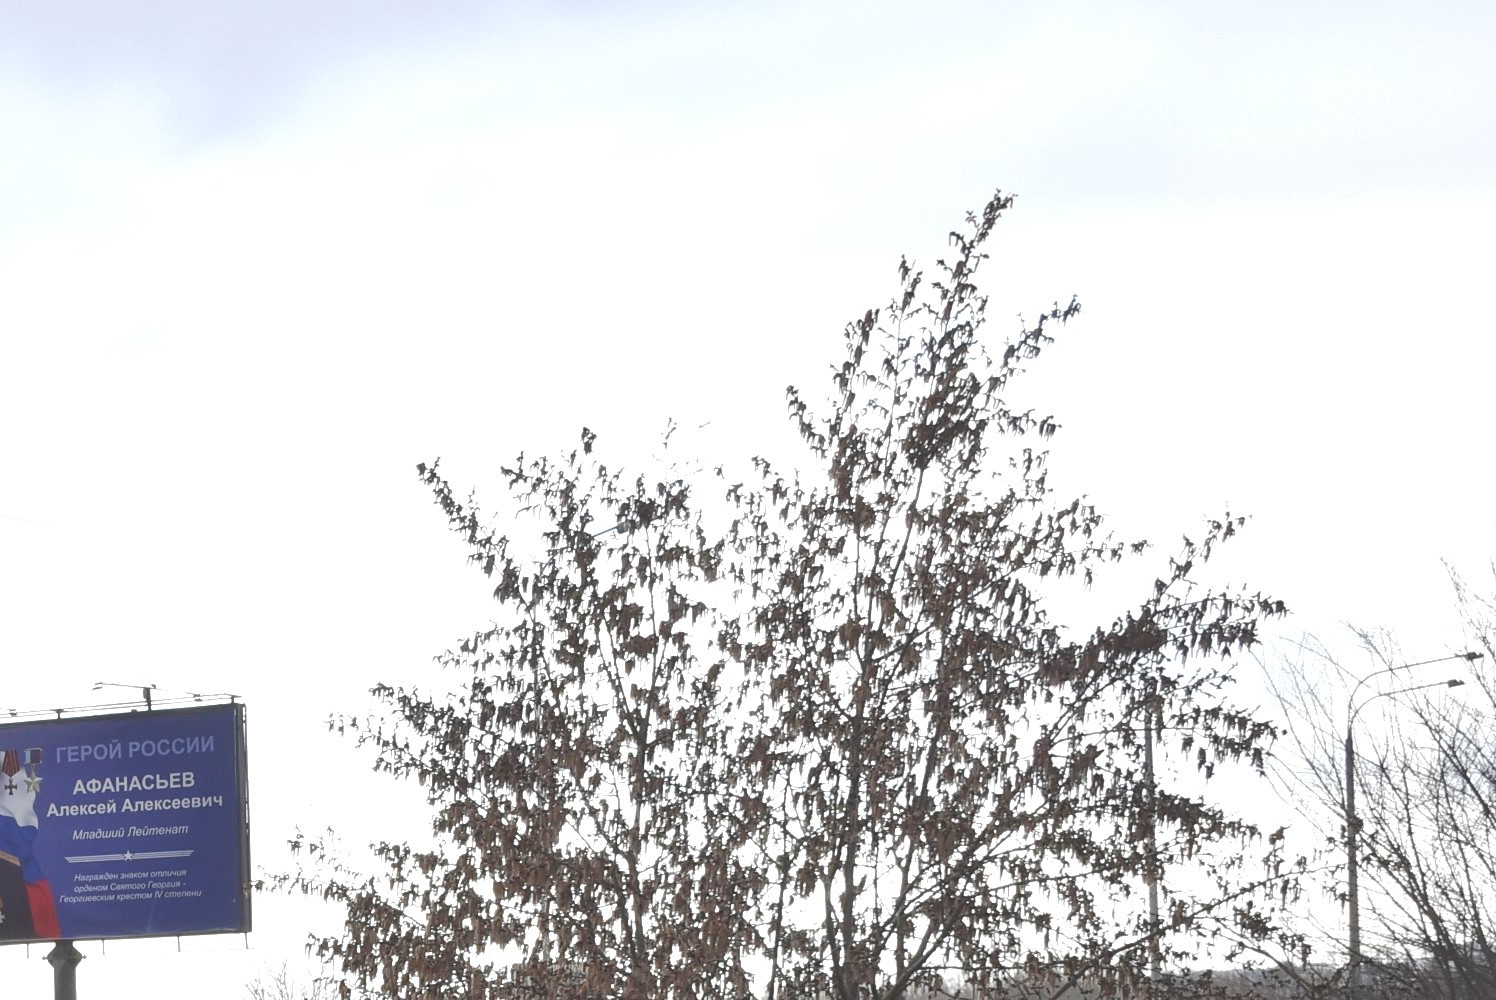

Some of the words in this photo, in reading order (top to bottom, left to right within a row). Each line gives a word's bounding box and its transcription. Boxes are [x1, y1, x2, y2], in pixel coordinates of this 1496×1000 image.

[56, 739, 121, 763] ГЕРОЙ
[129, 736, 214, 757] РОССИИ
[73, 772, 195, 795] АФАНАСЬЕВ
[47, 800, 117, 817] Алексей
[121, 795, 223, 813] Алексеевич
[72, 828, 125, 840] Младший
[74, 872, 119, 882] Награжден
[150, 869, 187, 877] отличия
[74, 884, 109, 893] орденом
[110, 882, 146, 890] Святого
[147, 880, 181, 889] Георгия
[59, 894, 115, 904] Георгиевским
[116, 892, 153, 901] крестом
[154, 890, 164, 898] IV
[164, 890, 202, 898] степени
